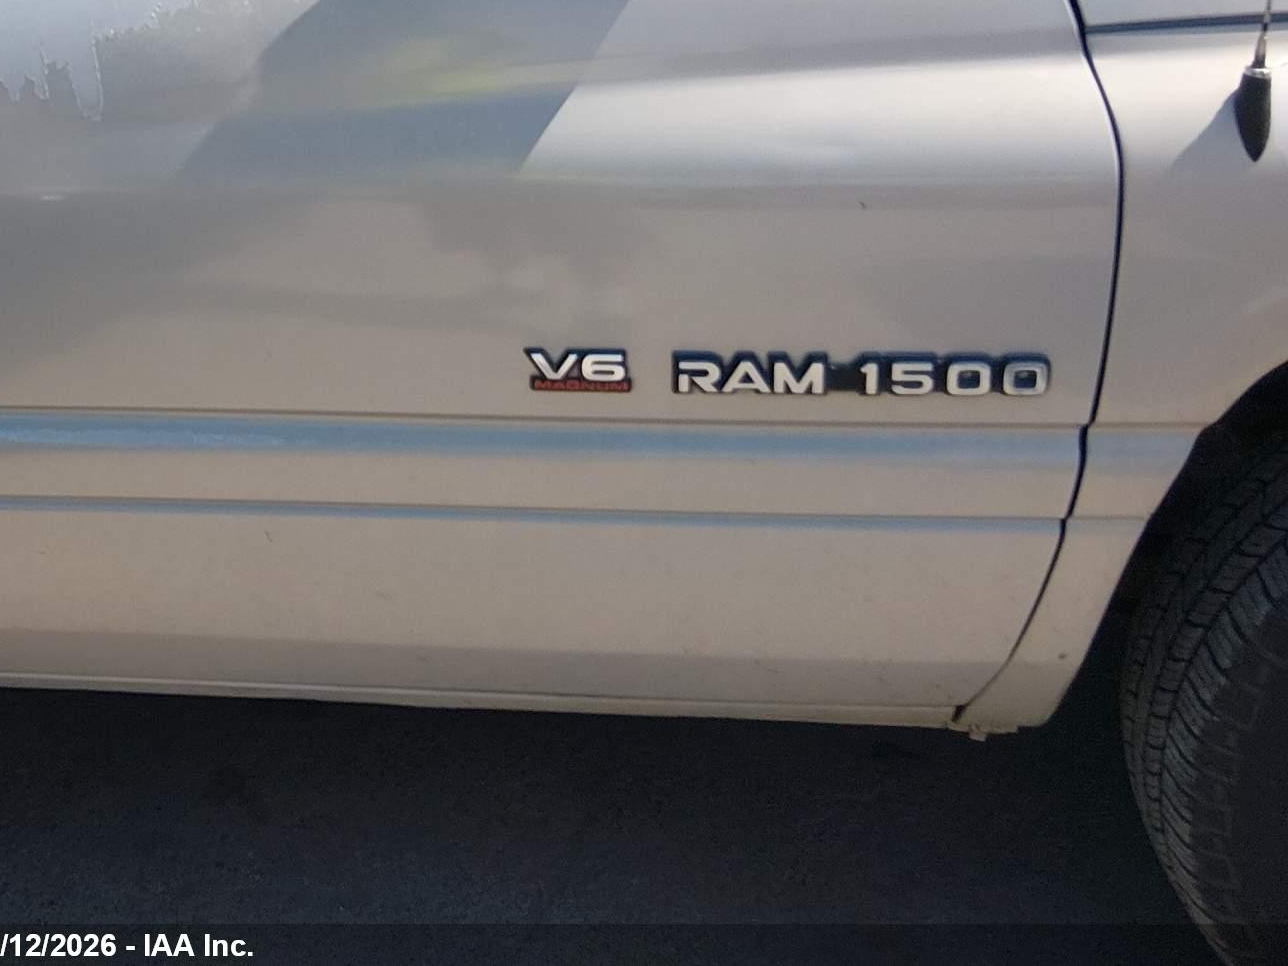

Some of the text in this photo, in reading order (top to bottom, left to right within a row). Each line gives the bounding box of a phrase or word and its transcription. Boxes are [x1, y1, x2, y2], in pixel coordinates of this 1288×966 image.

[527, 351, 627, 382] V6
[676, 357, 1049, 396] RAM 1500
